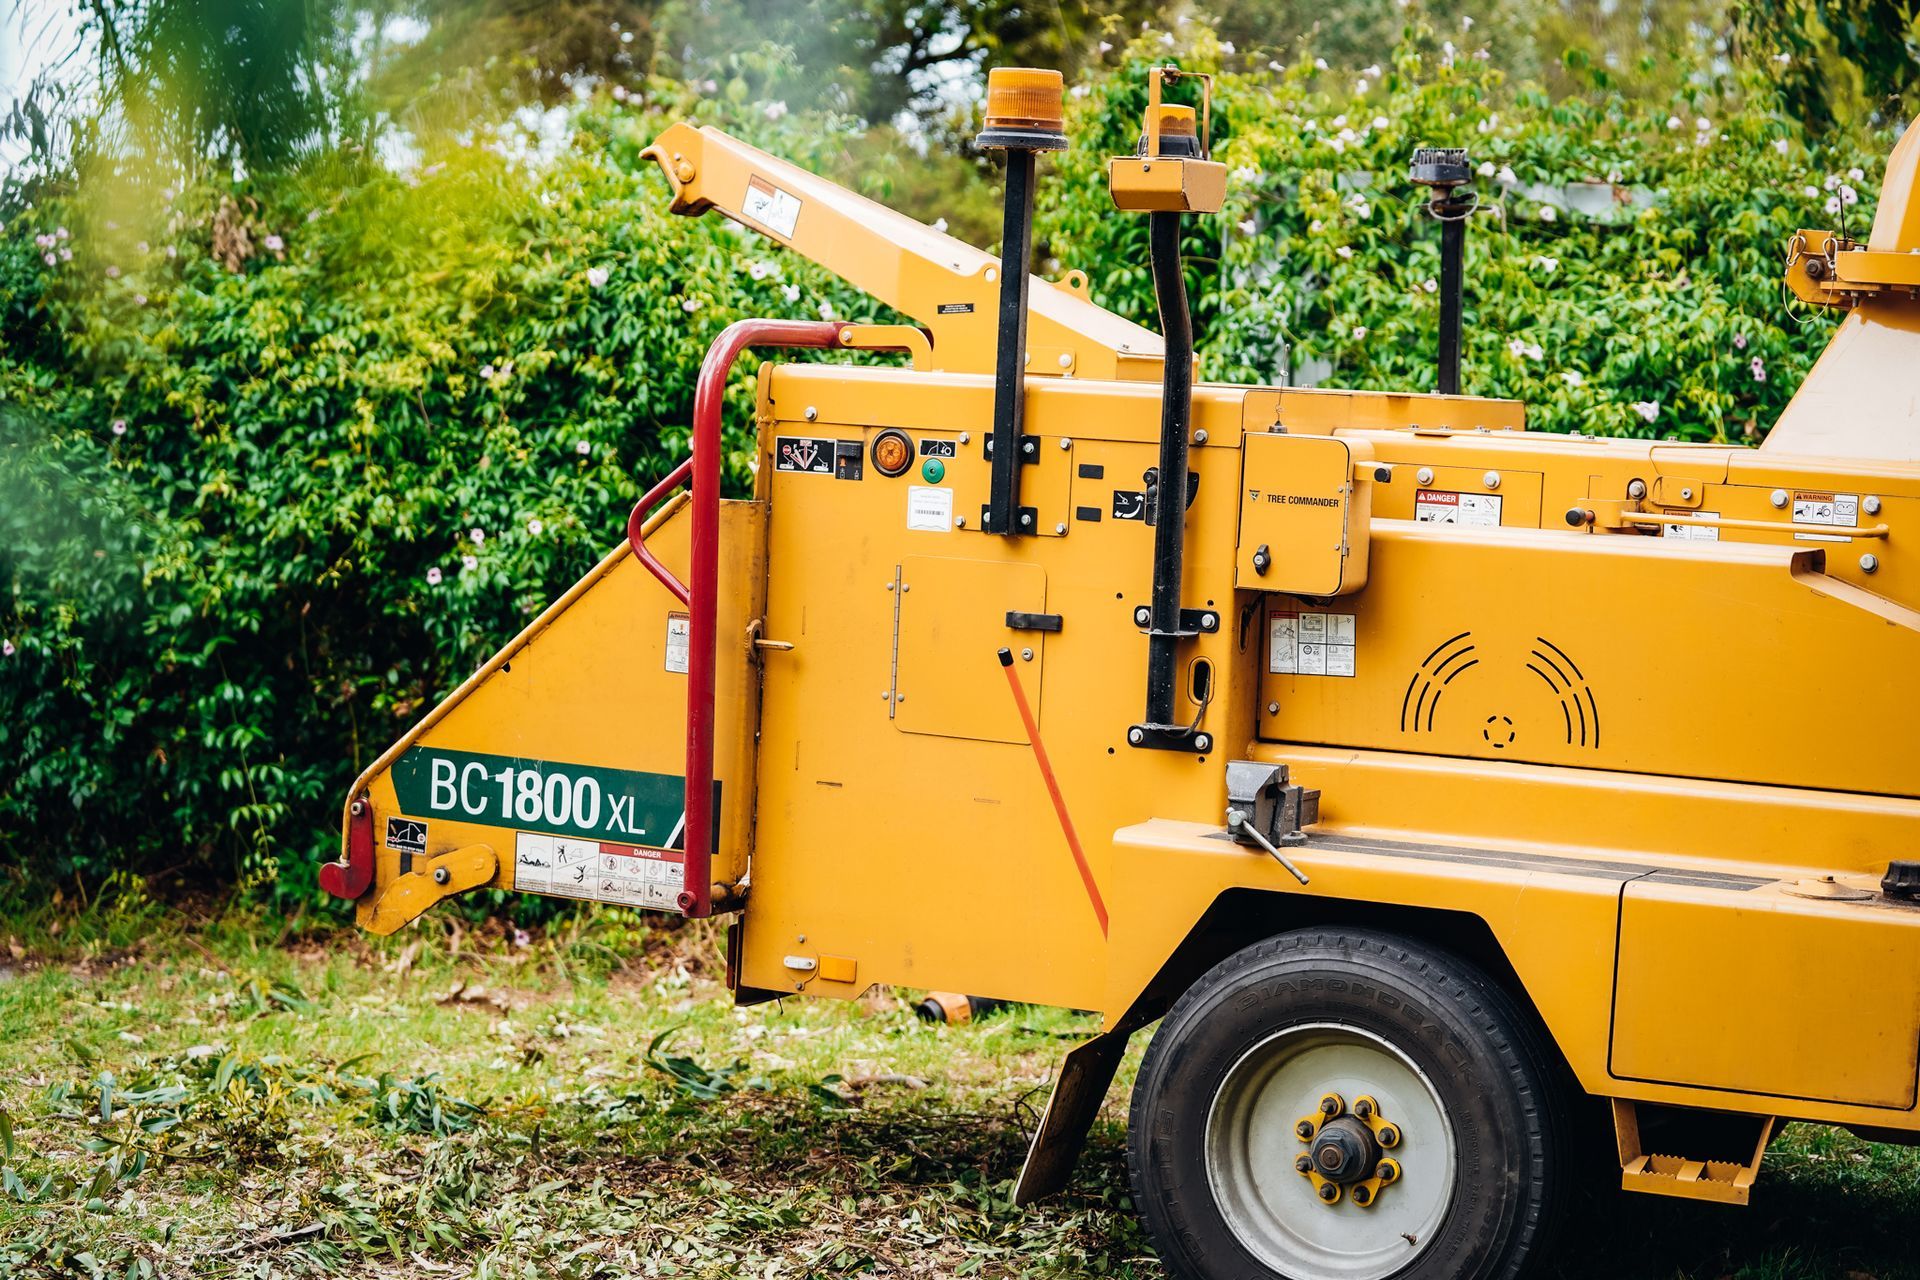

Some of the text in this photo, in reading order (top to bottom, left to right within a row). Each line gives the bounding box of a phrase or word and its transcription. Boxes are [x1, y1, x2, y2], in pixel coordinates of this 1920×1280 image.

[1267, 494, 1339, 508] TREE COMMANDER
[1426, 493, 1456, 503] DANGER
[1803, 494, 1833, 502] WARNING
[605, 793, 646, 835] XL
[633, 848, 662, 859] DANGER
[1235, 978, 1476, 1083] DIAMONDBACK
